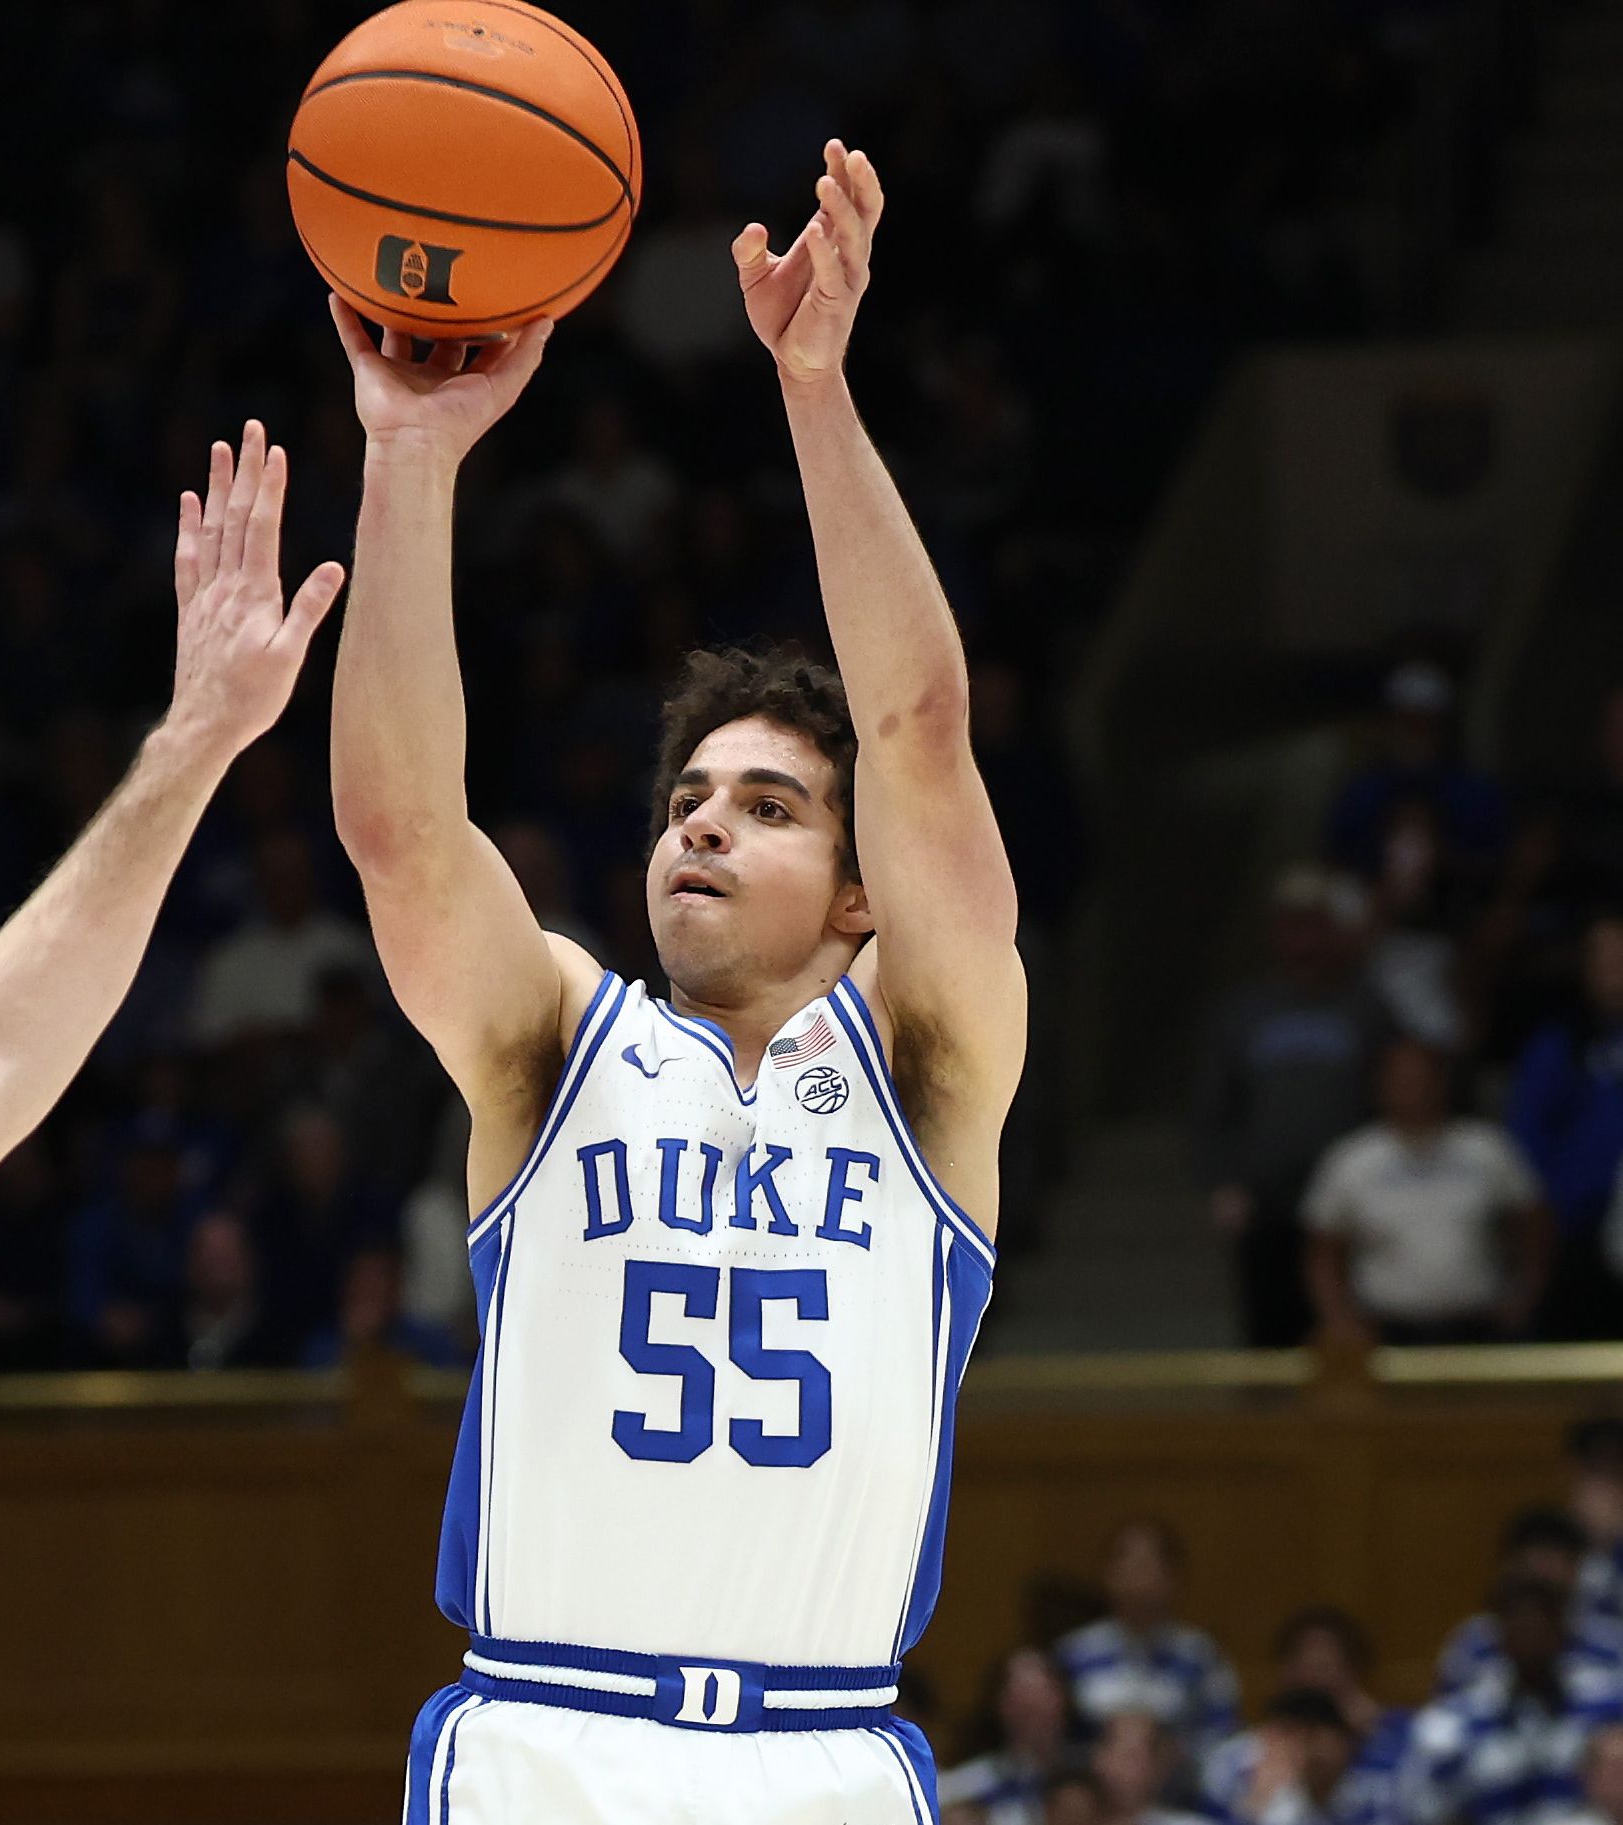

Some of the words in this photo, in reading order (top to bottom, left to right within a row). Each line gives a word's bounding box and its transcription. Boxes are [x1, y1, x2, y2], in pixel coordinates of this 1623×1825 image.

[803, 1075, 843, 1099] ACC
[577, 1137, 880, 1251] DUKE
[611, 1259, 832, 1468] 55
[674, 1667, 741, 1726] D
